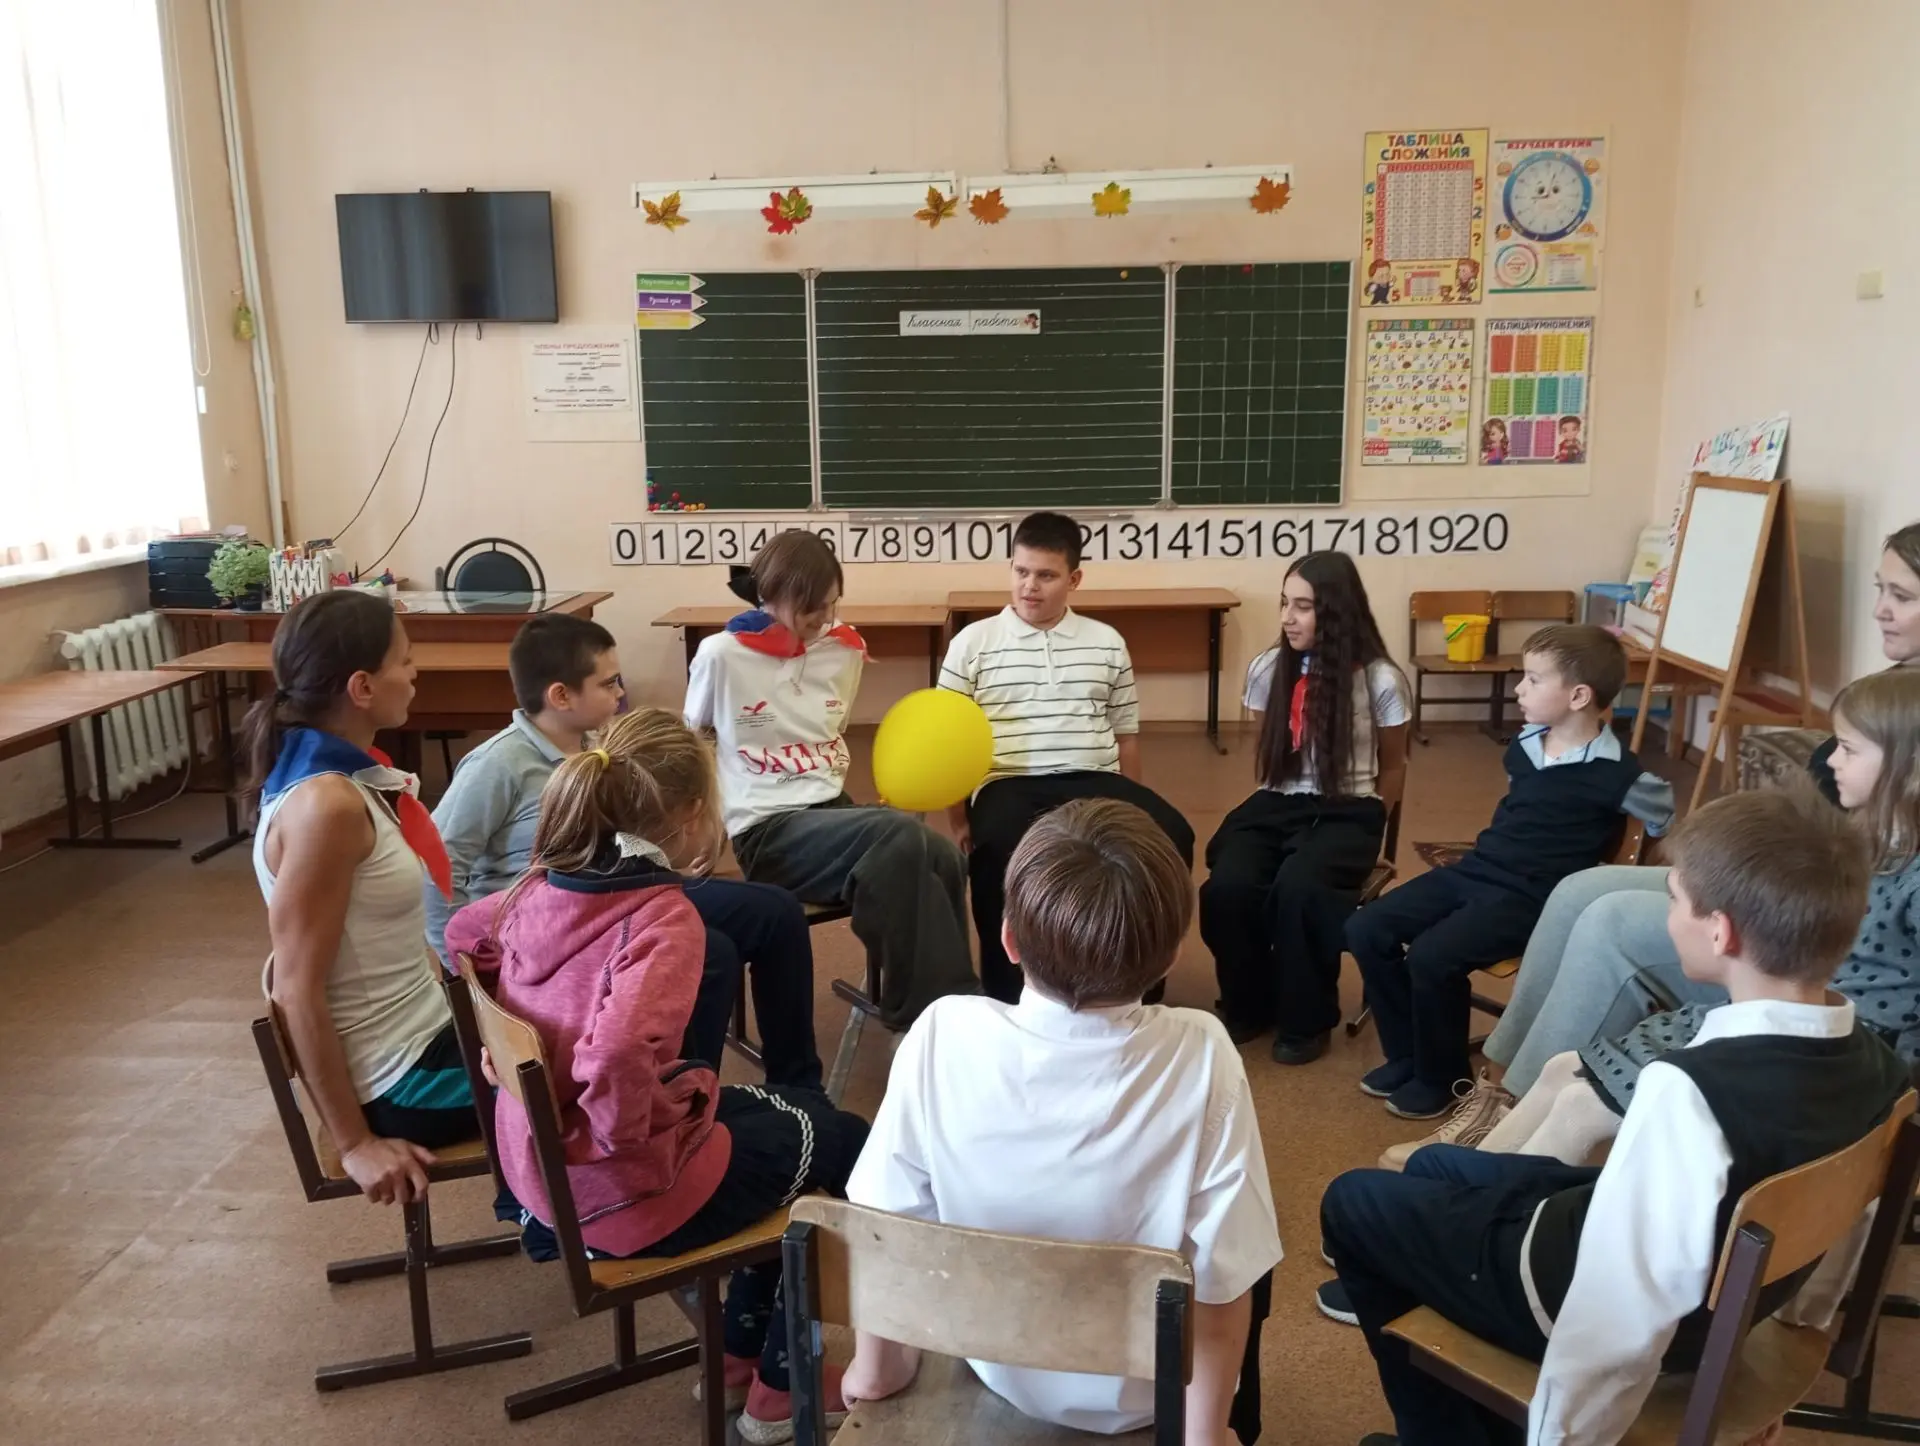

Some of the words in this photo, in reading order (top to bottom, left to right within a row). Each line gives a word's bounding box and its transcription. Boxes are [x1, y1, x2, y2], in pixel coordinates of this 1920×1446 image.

[1387, 133, 1465, 147] ТАБЛИЦА
[1380, 146, 1471, 160] СЛОЖЕНИЯ
[1364, 183, 1375, 195] 6
[1474, 178, 1483, 190] 5
[1365, 212, 1374, 224] 3
[1472, 206, 1482, 219] 2
[1472, 232, 1482, 246] ?
[906, 314, 962, 328] Классная
[972, 312, 1019, 331] работа
[1490, 321, 1530, 330] ТАБЛИЦА
[1534, 320, 1590, 329] УМНОЖЕНИЯ
[616, 528, 636, 560] 0
[652, 528, 665, 560] 1
[685, 528, 705, 560] 2
[718, 528, 738, 559] 3
[817, 528, 836, 554] 6
[849, 527, 869, 557] 7
[881, 527, 901, 557] 8
[914, 526, 934, 557] 9
[941, 521, 993, 560] 10
[1094, 523, 1143, 560] 13
[1144, 521, 1193, 560] 14
[1195, 519, 1245, 557] 15
[1247, 520, 1297, 558] 16
[1298, 518, 1349, 554] 17
[1350, 517, 1400, 556] 18
[1403, 516, 1454, 554] 19
[1454, 513, 1508, 552] 20
